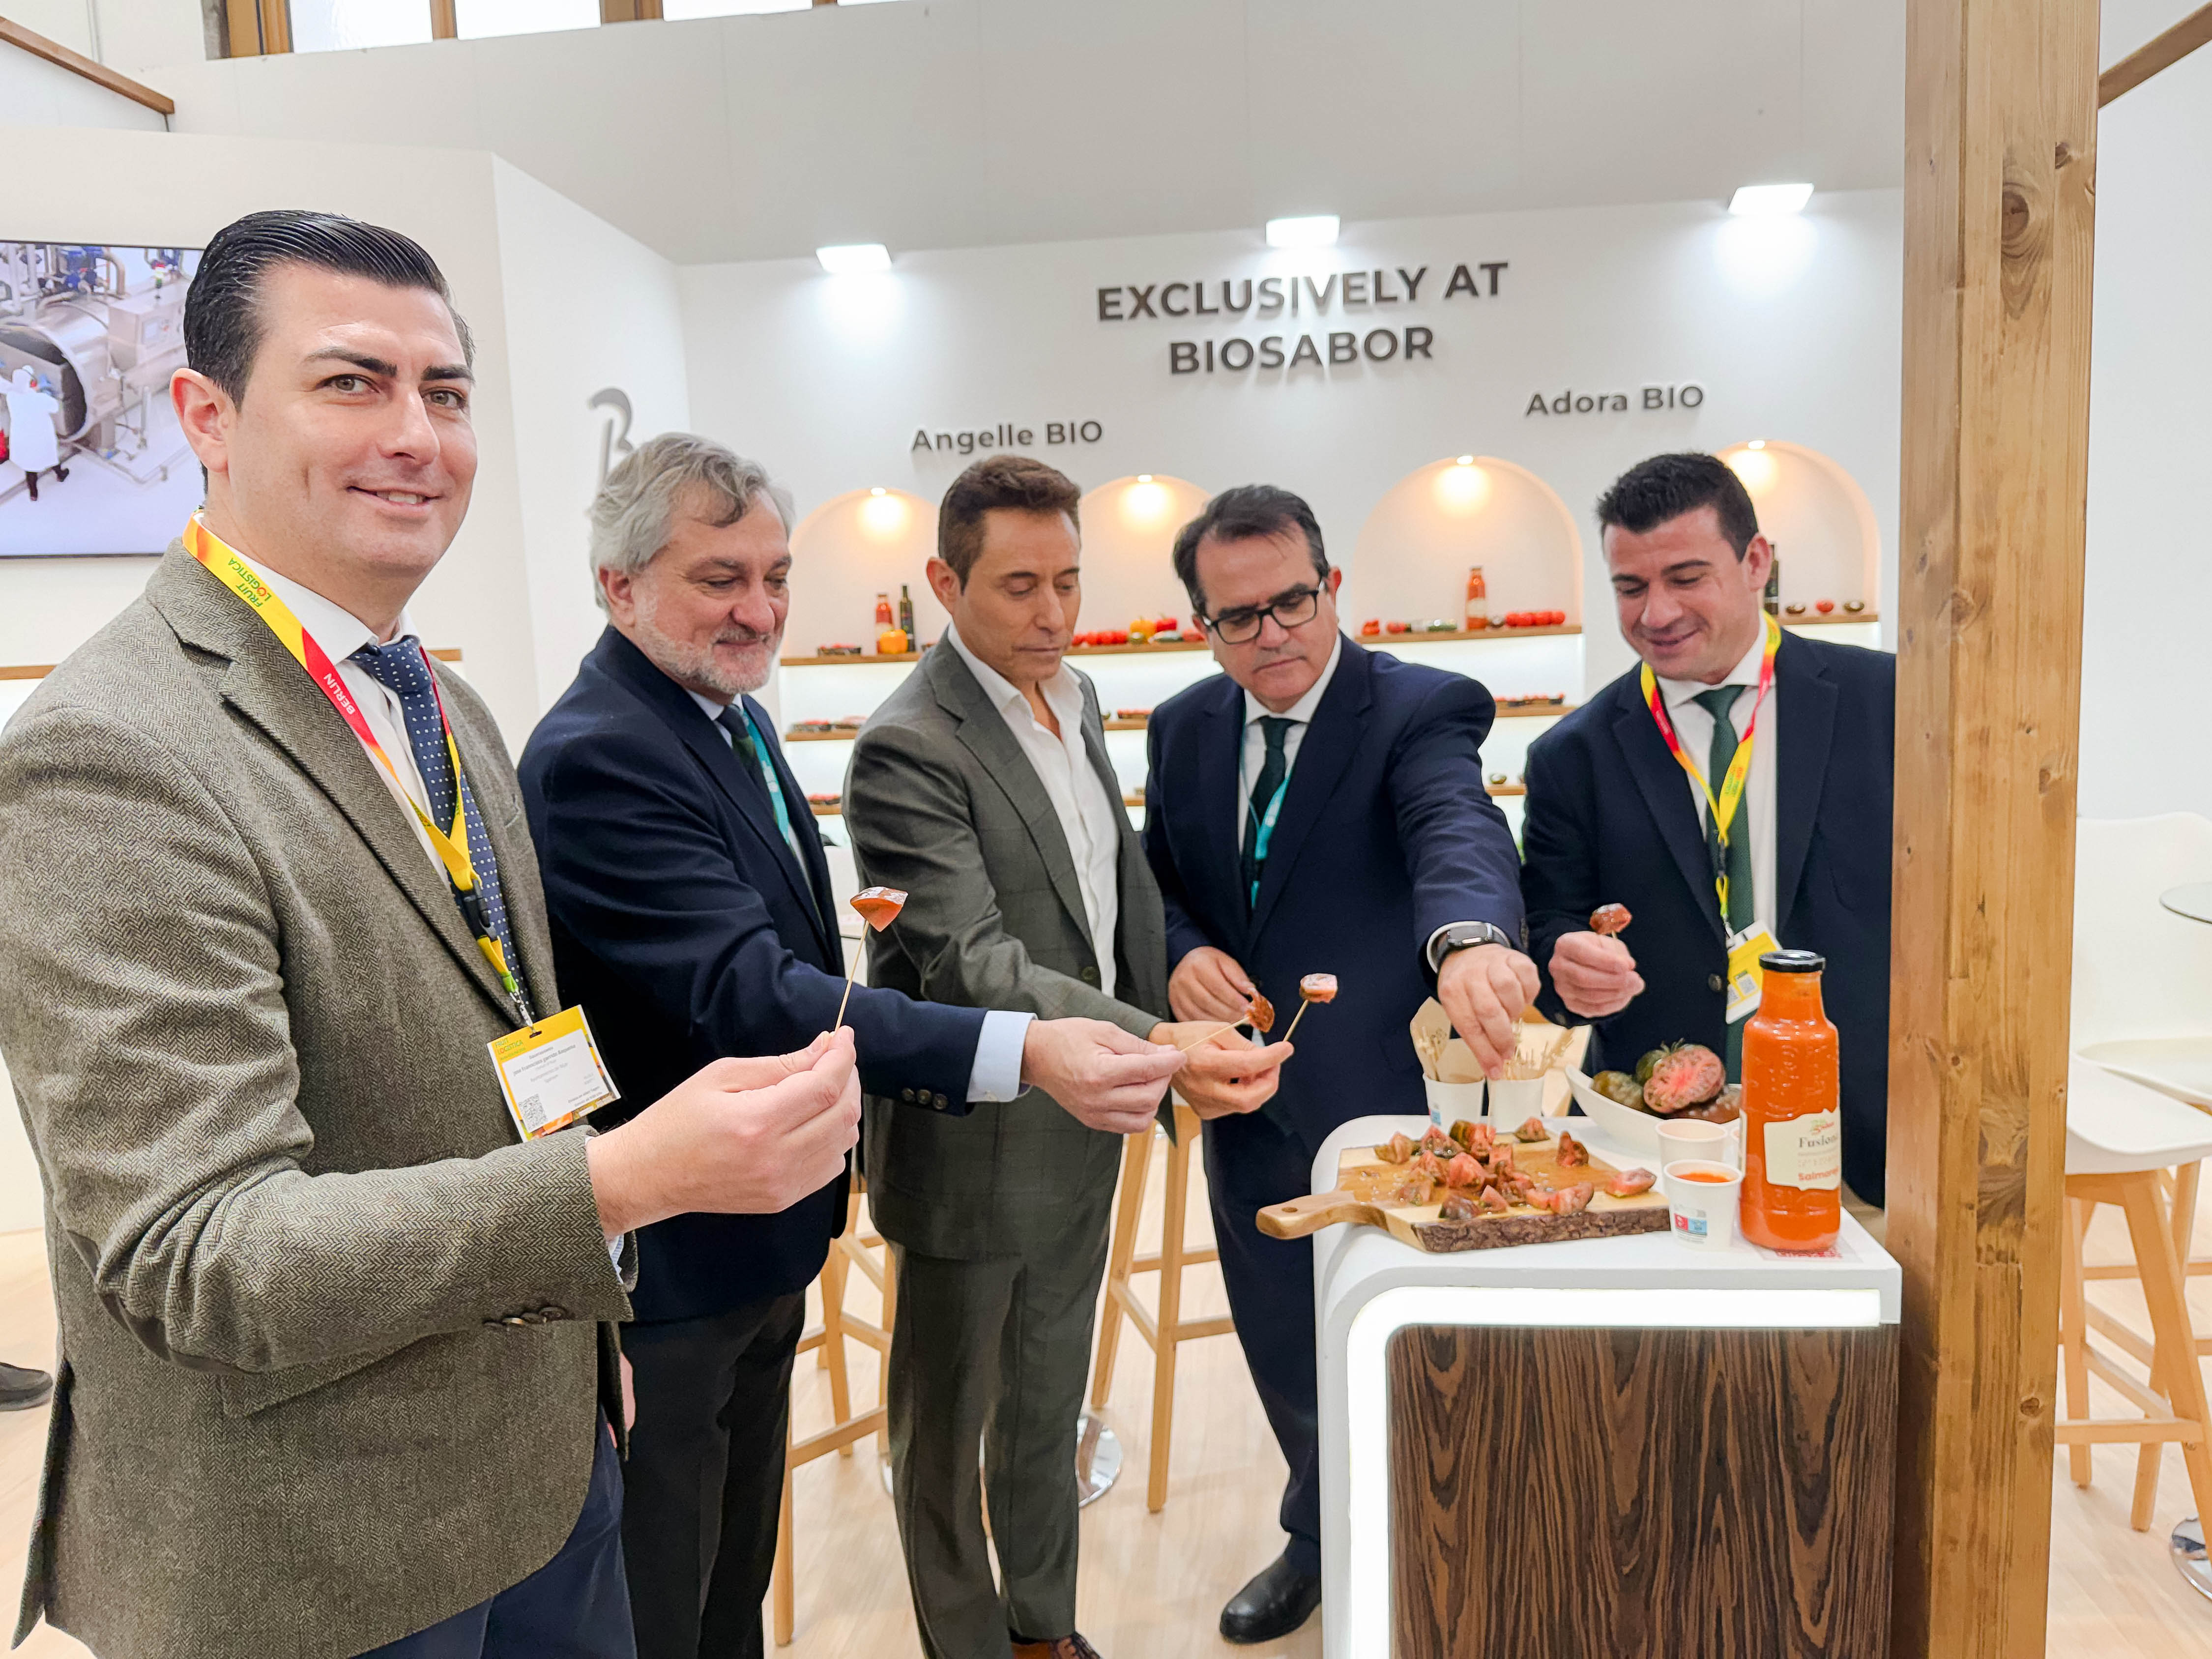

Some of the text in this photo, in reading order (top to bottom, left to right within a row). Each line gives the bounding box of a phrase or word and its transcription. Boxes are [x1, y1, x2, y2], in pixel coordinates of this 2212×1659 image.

[1097, 261, 1509, 321] EXCLUSIVELY AT
[1169, 326, 1433, 375] BIOSABOR
[1526, 386, 1703, 416] Adora BIO
[912, 421, 1103, 455] Angelle BIO
[228, 557, 272, 601] LOGISTICA
[235, 583, 263, 607] FRUIT
[323, 673, 355, 715] BERLIN
